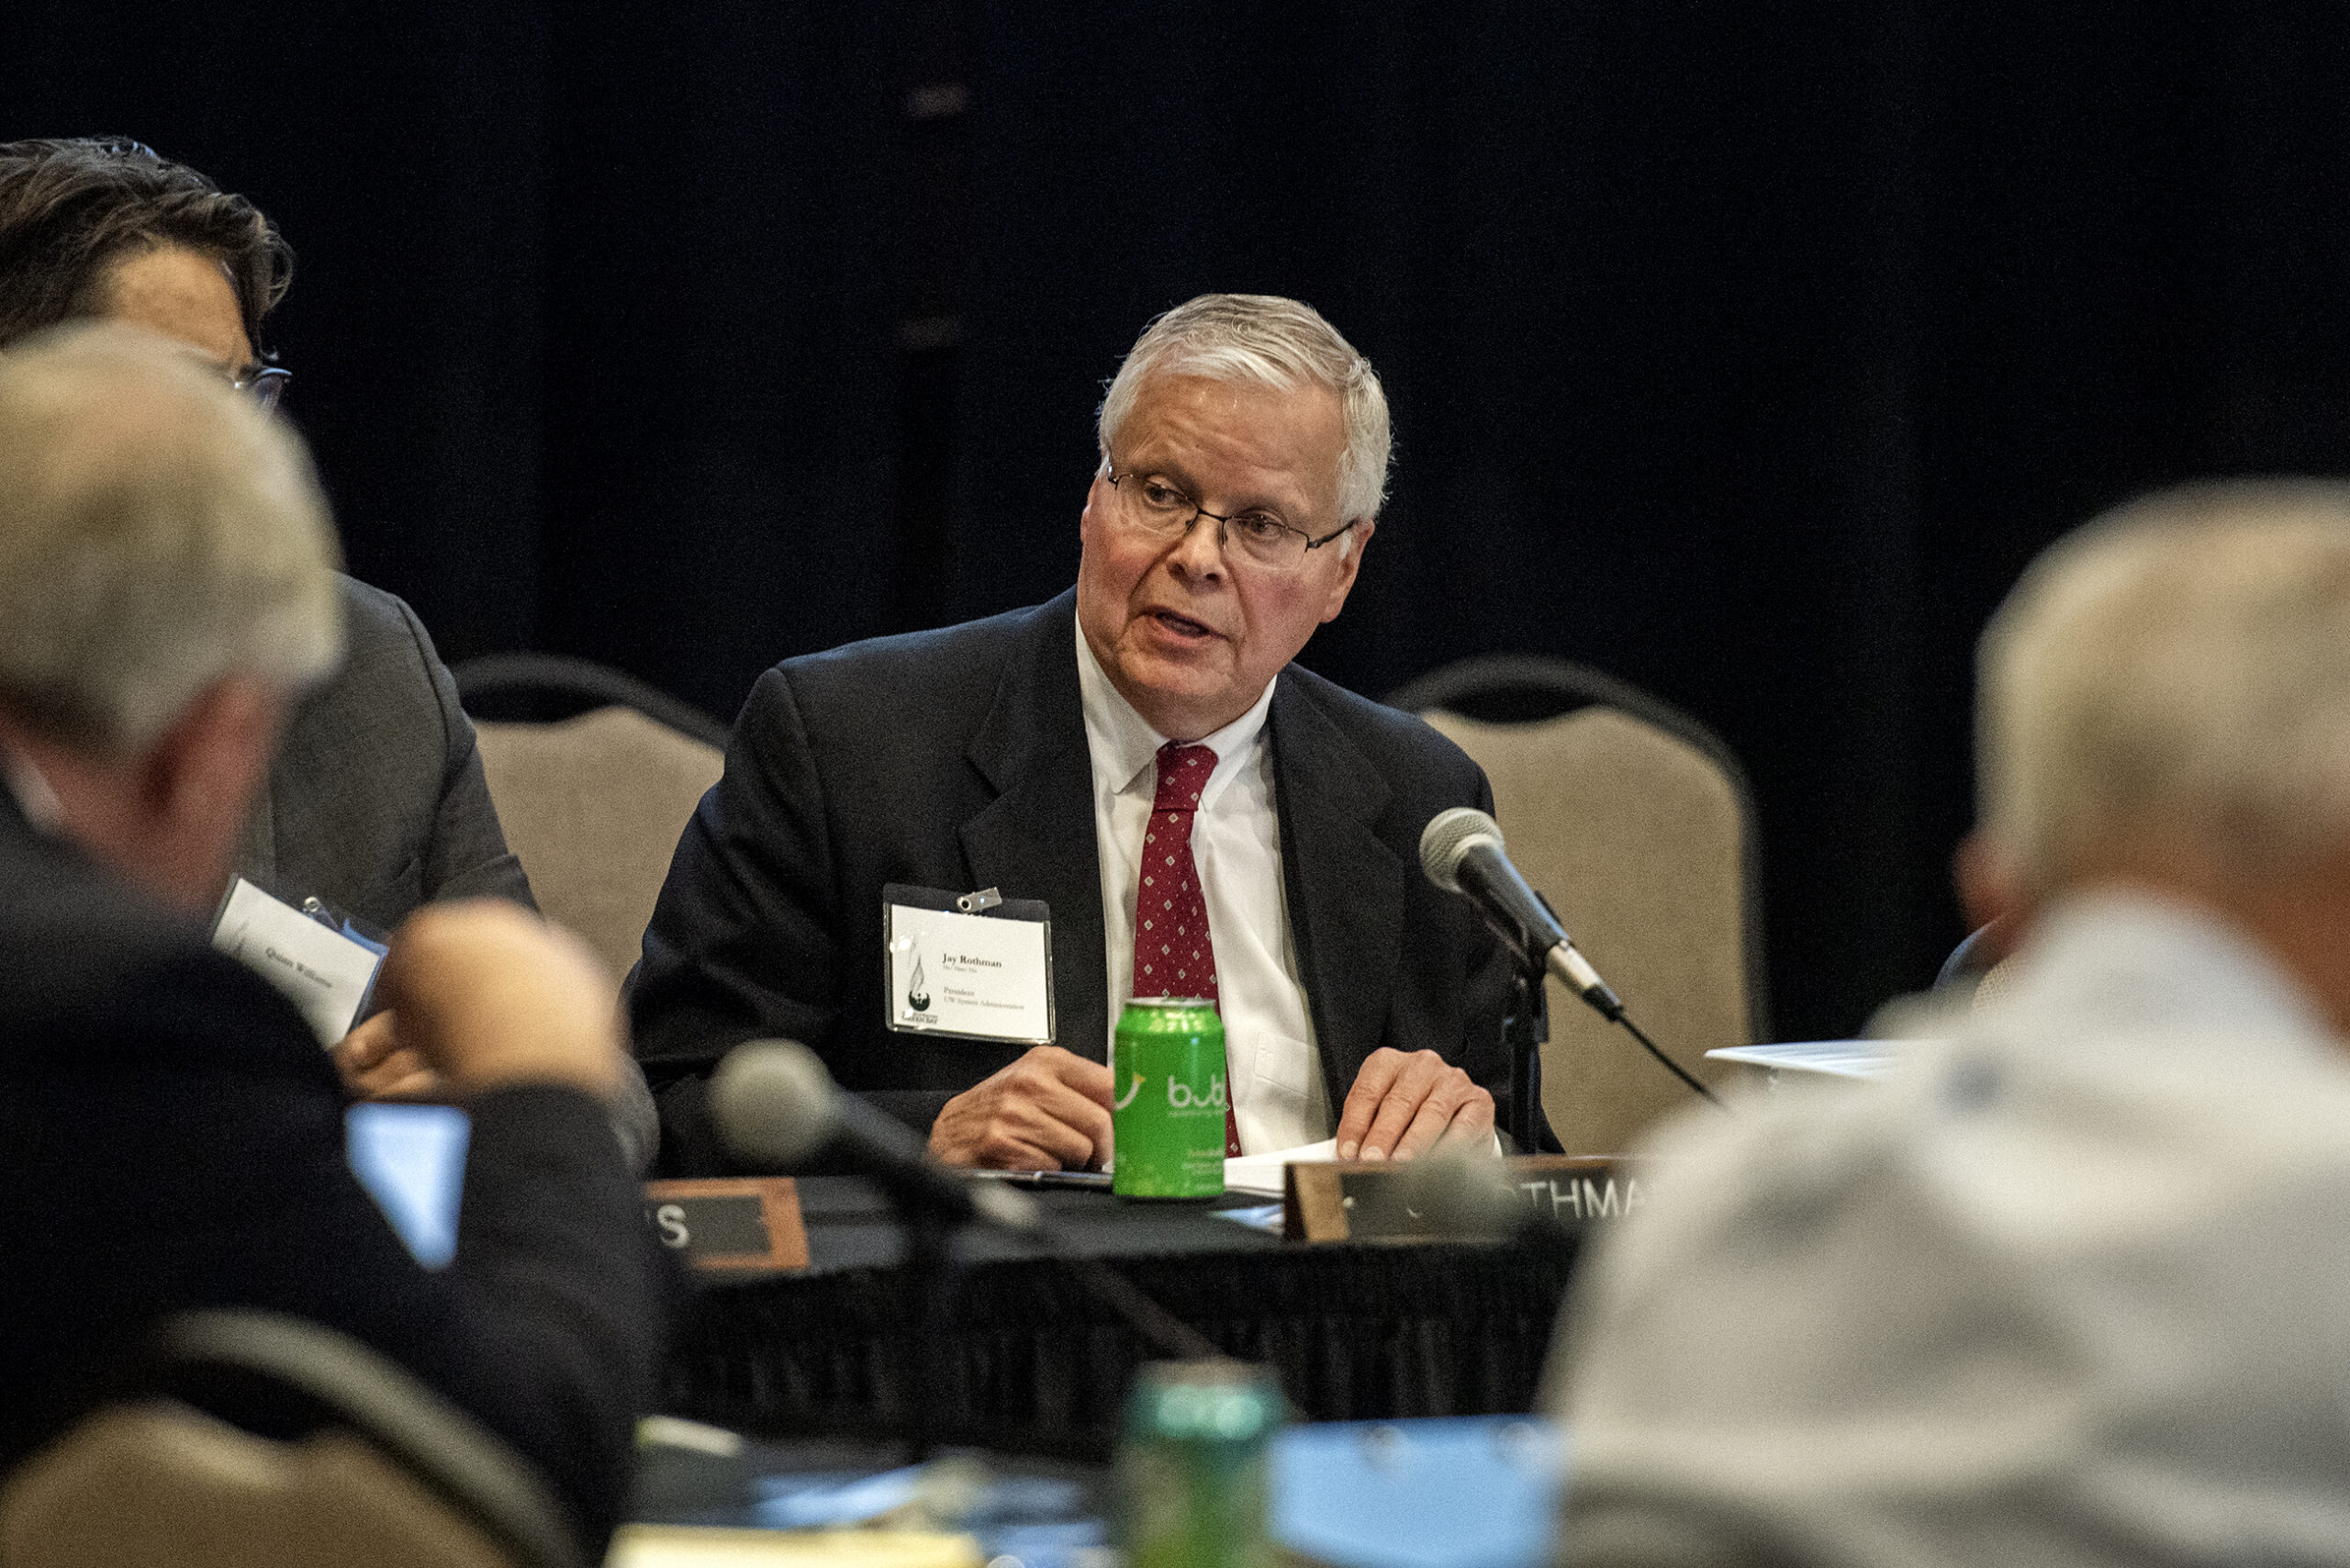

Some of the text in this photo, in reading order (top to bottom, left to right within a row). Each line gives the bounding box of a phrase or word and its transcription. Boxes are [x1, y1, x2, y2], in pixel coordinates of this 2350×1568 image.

[942, 952, 1002, 968] Jay Rothman
[646, 1204, 690, 1249] S
